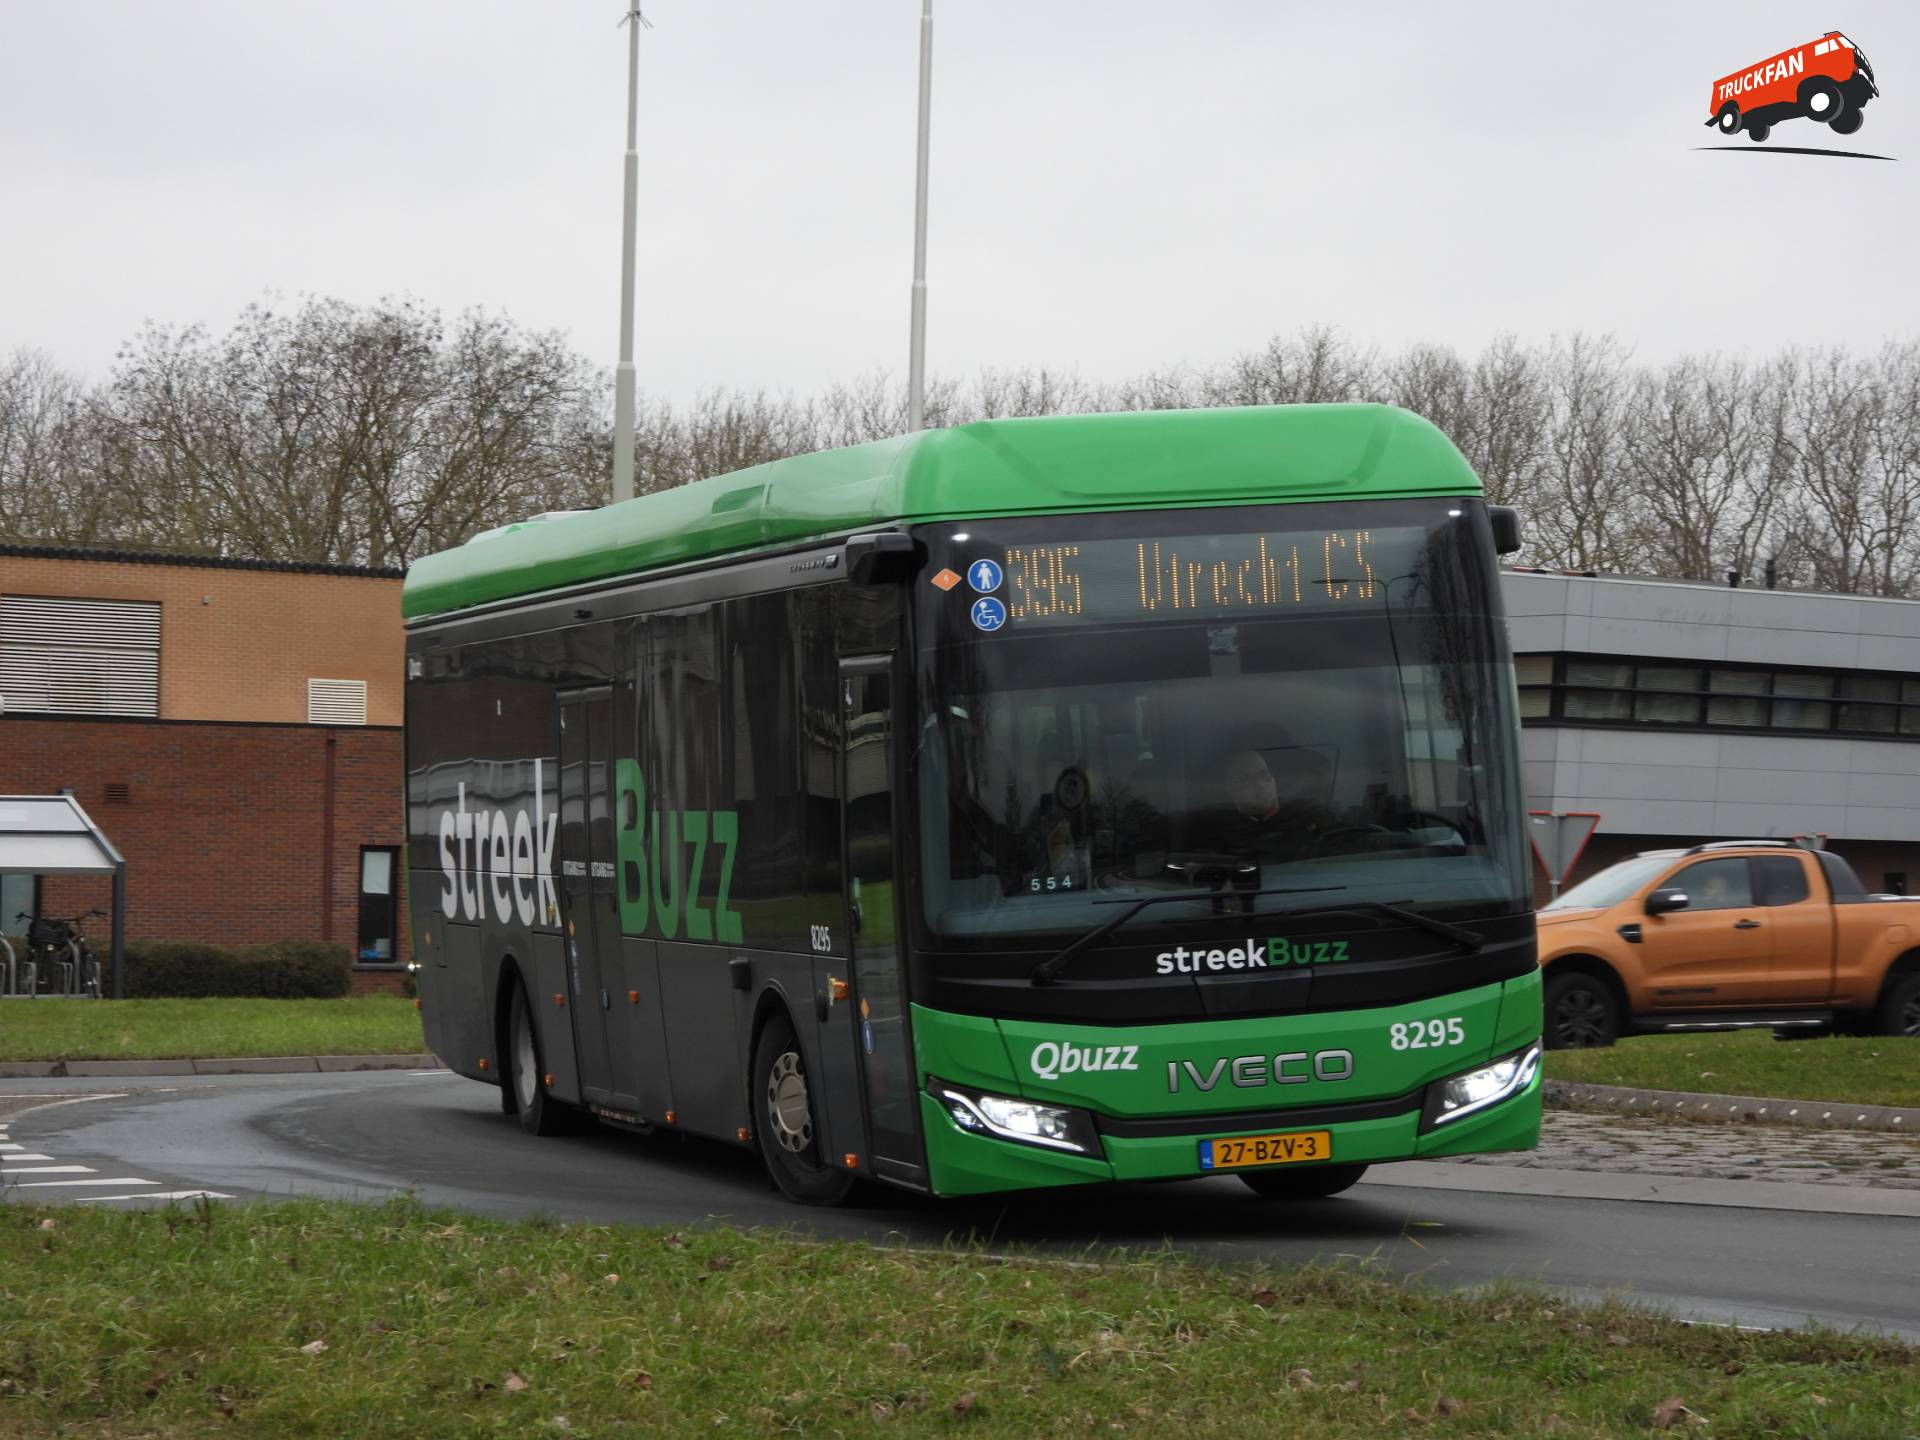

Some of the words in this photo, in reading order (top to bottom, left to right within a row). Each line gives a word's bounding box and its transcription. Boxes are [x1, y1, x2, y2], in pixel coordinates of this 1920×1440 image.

[1006, 546, 1081, 617] 395
[1137, 536, 1303, 611] Utrecht
[1322, 531, 1374, 600] CS
[810, 924, 831, 952] 8295
[1156, 937, 1350, 975] streekBuzz
[1389, 1016, 1465, 1052] 8295
[1030, 1041, 1139, 1081] Qbuzz
[1167, 1048, 1354, 1095] IVECO
[1220, 1137, 1316, 1164] 27-BZV-3
